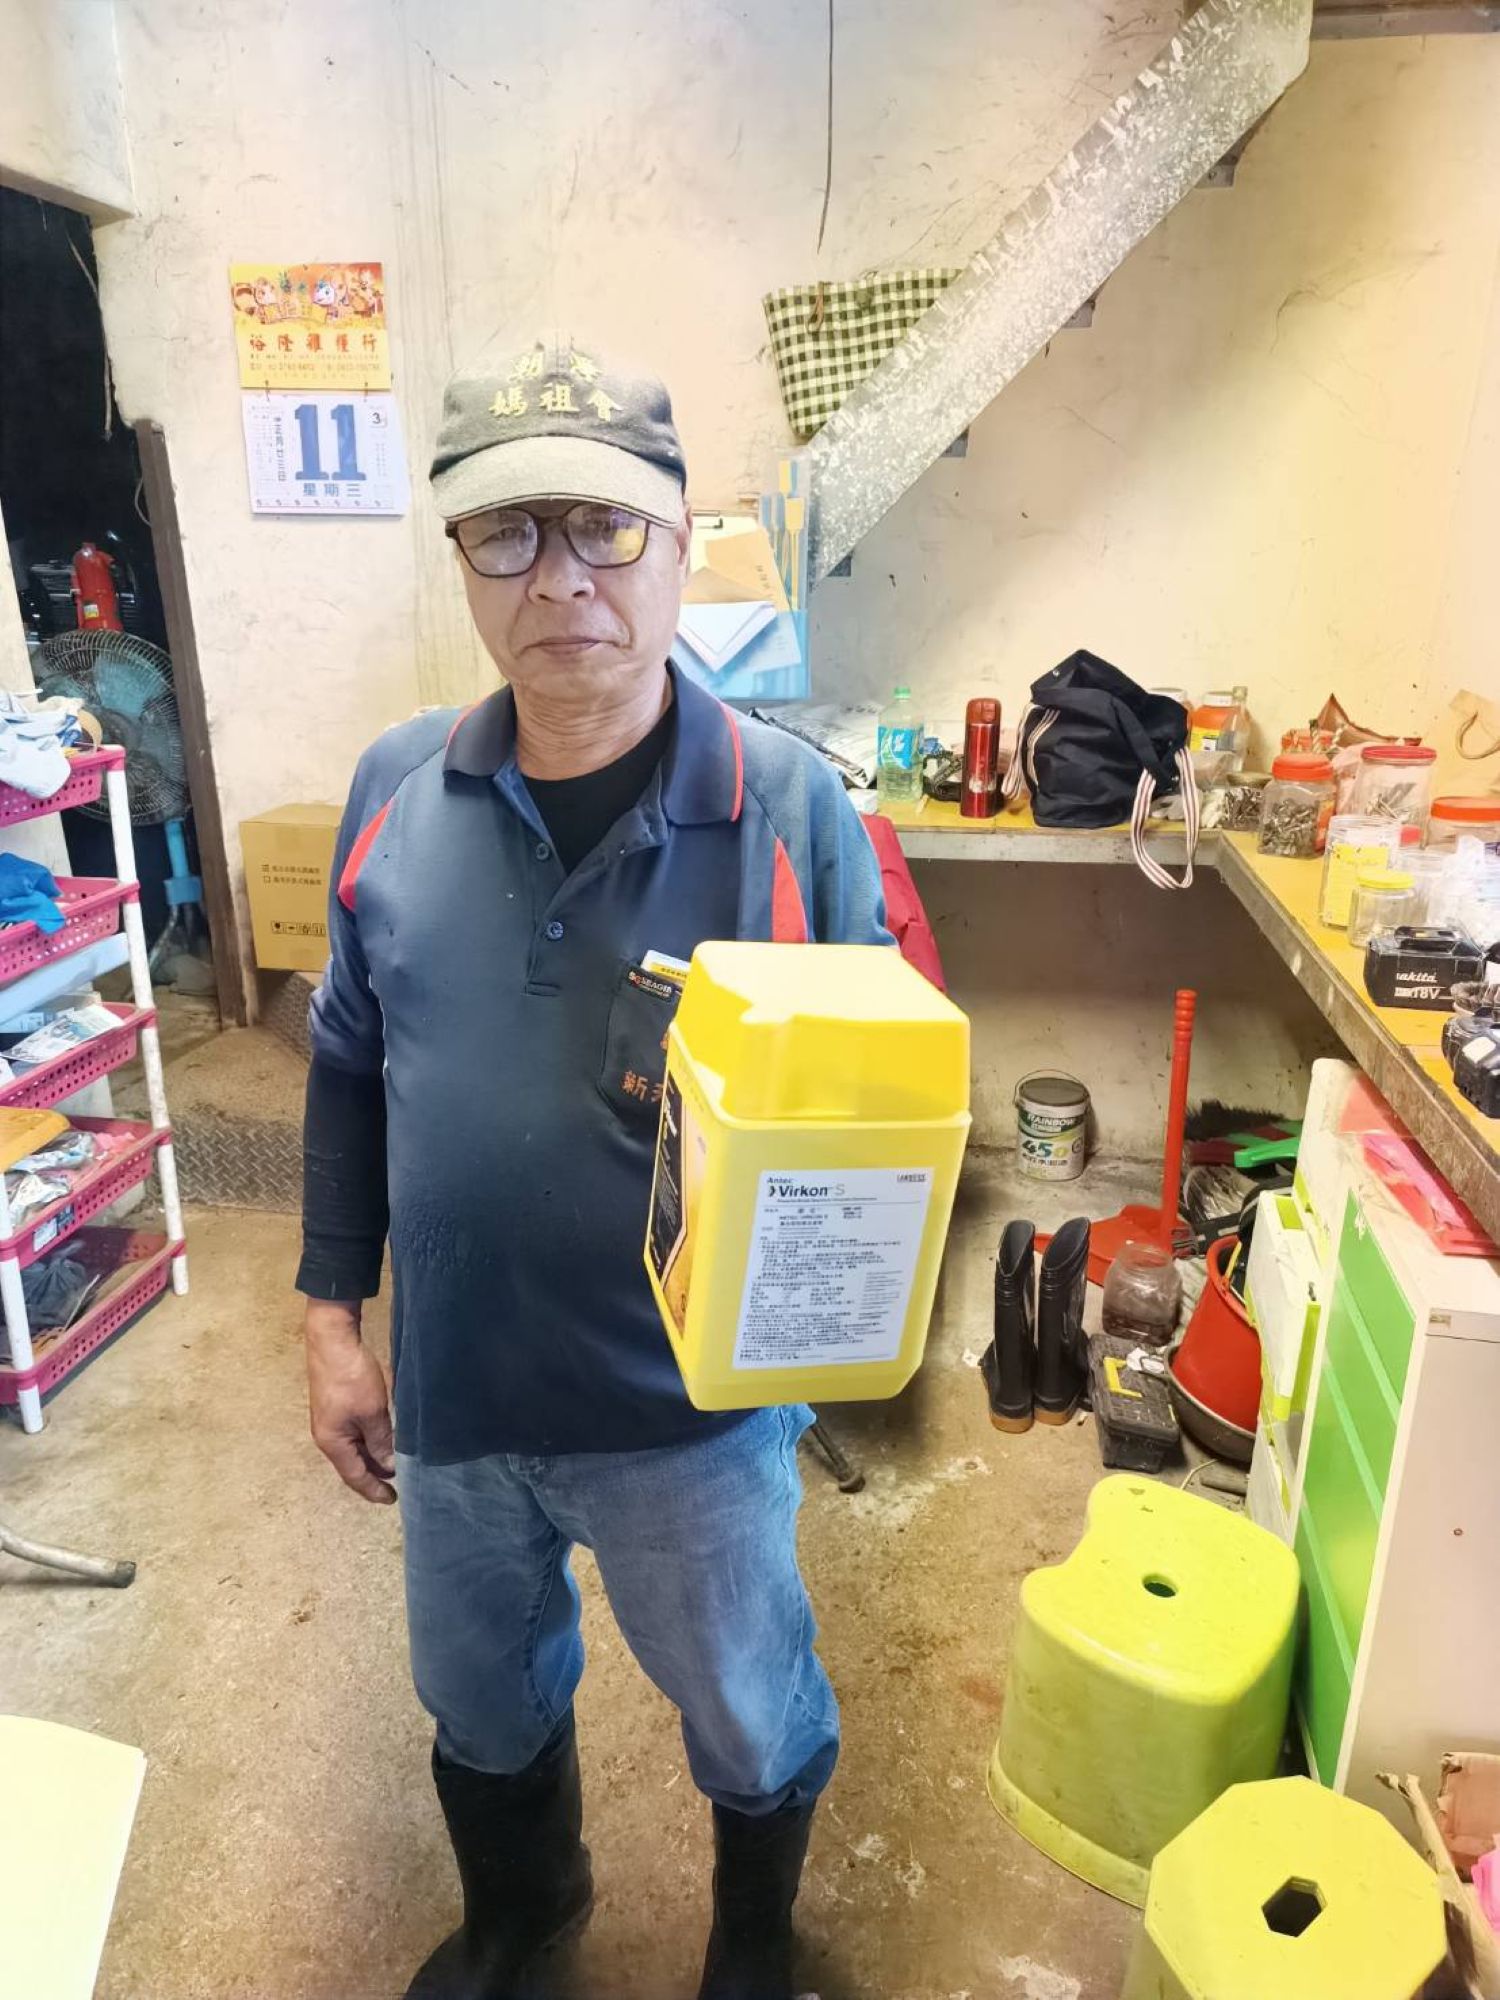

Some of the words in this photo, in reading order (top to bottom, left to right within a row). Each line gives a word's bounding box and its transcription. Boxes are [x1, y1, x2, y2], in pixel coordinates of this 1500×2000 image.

[371, 412, 382, 425] 3
[294, 404, 367, 481] 11
[303, 483, 362, 498] 星期三
[778, 1184, 829, 1198] Virkon
